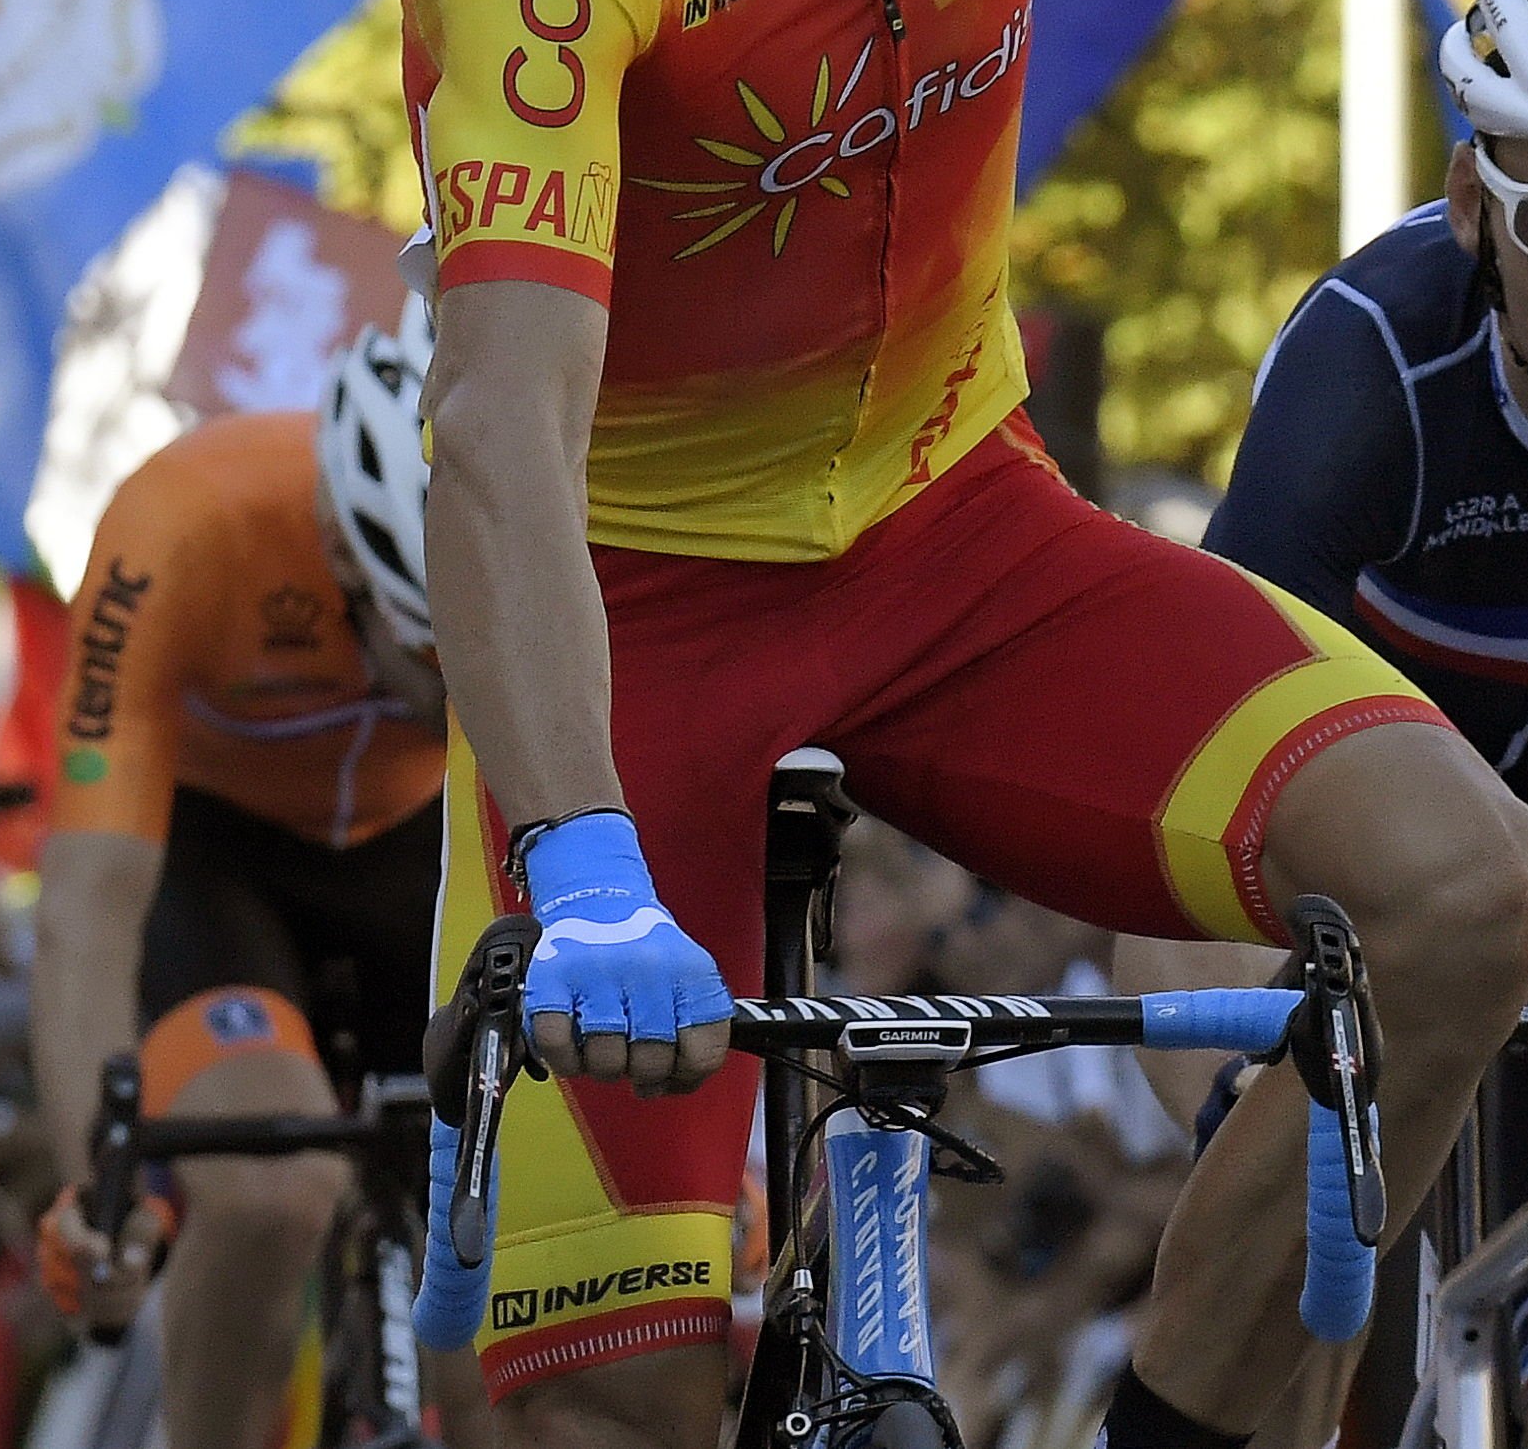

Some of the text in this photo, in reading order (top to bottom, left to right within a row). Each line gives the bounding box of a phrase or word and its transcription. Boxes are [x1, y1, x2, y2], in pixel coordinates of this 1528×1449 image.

[435, 159, 616, 254] ESPAÑ
[878, 1029, 941, 1042] GARMIN
[492, 1259, 710, 1330] IN INVERSE
[850, 1149, 884, 1357] CANYON
